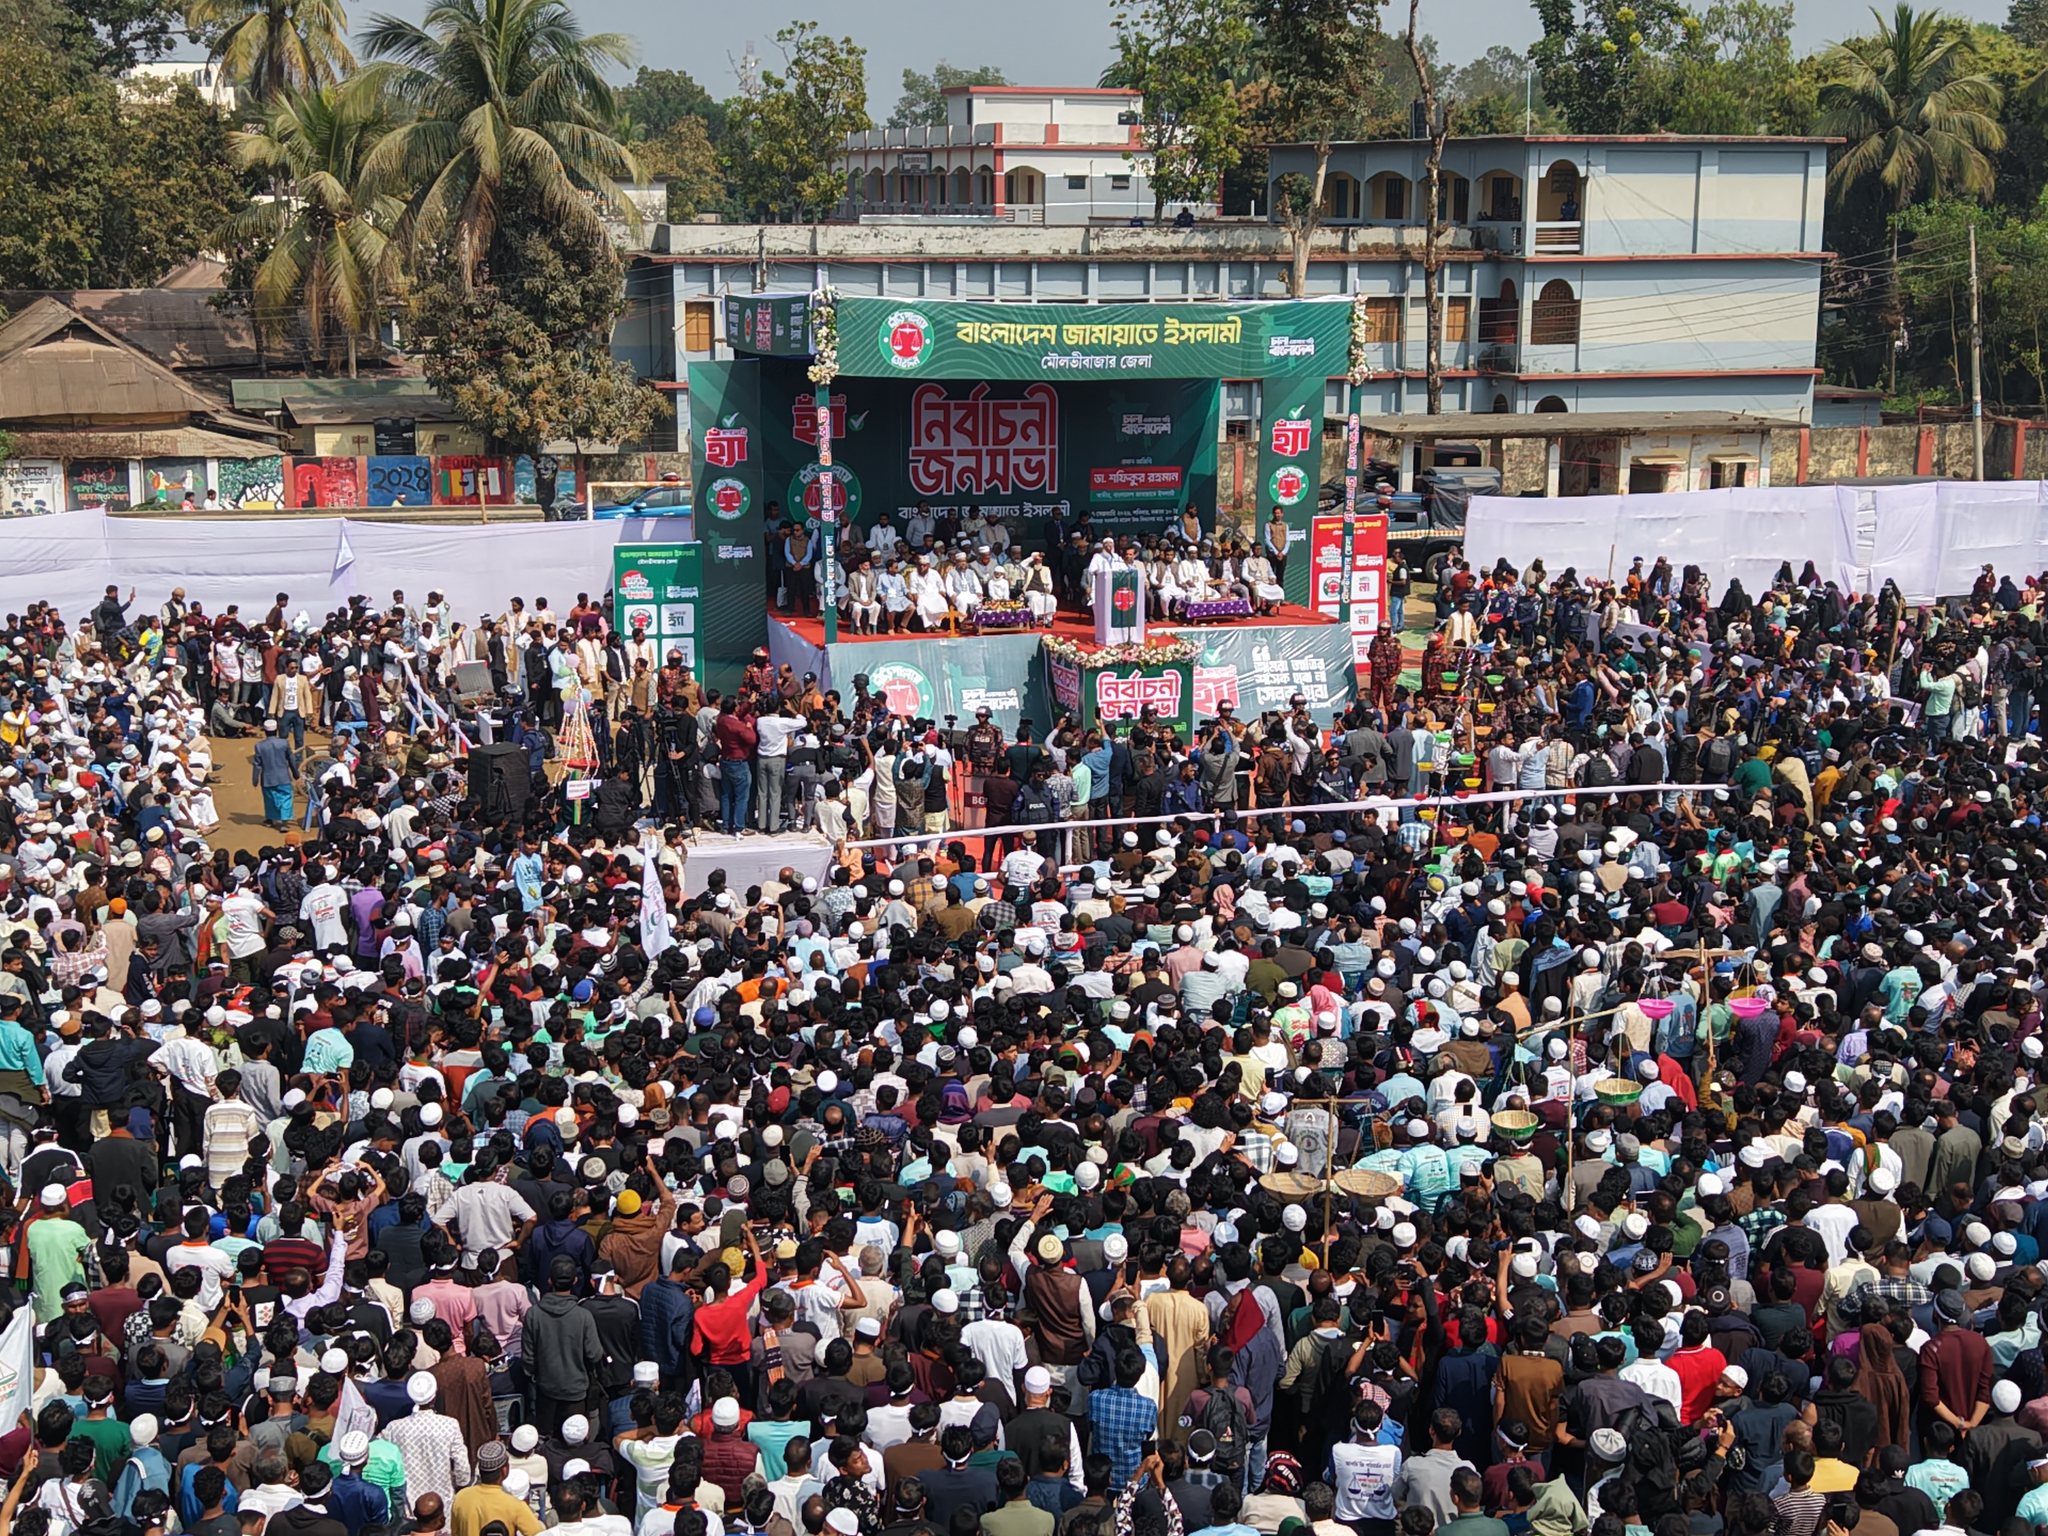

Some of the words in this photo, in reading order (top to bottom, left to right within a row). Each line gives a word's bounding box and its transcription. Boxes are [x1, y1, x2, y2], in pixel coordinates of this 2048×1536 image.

[956, 322, 1056, 345] বাংলাদেশ
[1063, 322, 1158, 346] জামায়াতে
[1164, 316, 1242, 345] ইসলামী
[1041, 352, 1116, 370] মৌলভীবাজার
[1120, 354, 1152, 369] জেলা
[912, 381, 1058, 448] নির্বাচনী
[1122, 423, 1171, 434] বাংলাদেশ
[1272, 418, 1311, 456] হ্যাঁ
[704, 427, 748, 468] হ্যাঁ
[910, 448, 1058, 495] জনসভা
[1094, 474, 1106, 484] ডা.
[1109, 470, 1146, 486] শফিকুর
[1148, 472, 1178, 482] রহমান
[1291, 654, 1326, 671] জাতির
[1096, 669, 1182, 700] নির্বাচনী
[1254, 673, 1290, 685] শাসক
[1314, 671, 1327, 682] না
[1256, 685, 1298, 705] সেবক
[1098, 697, 1180, 721] জনভা
[972, 796, 988, 804] BG
